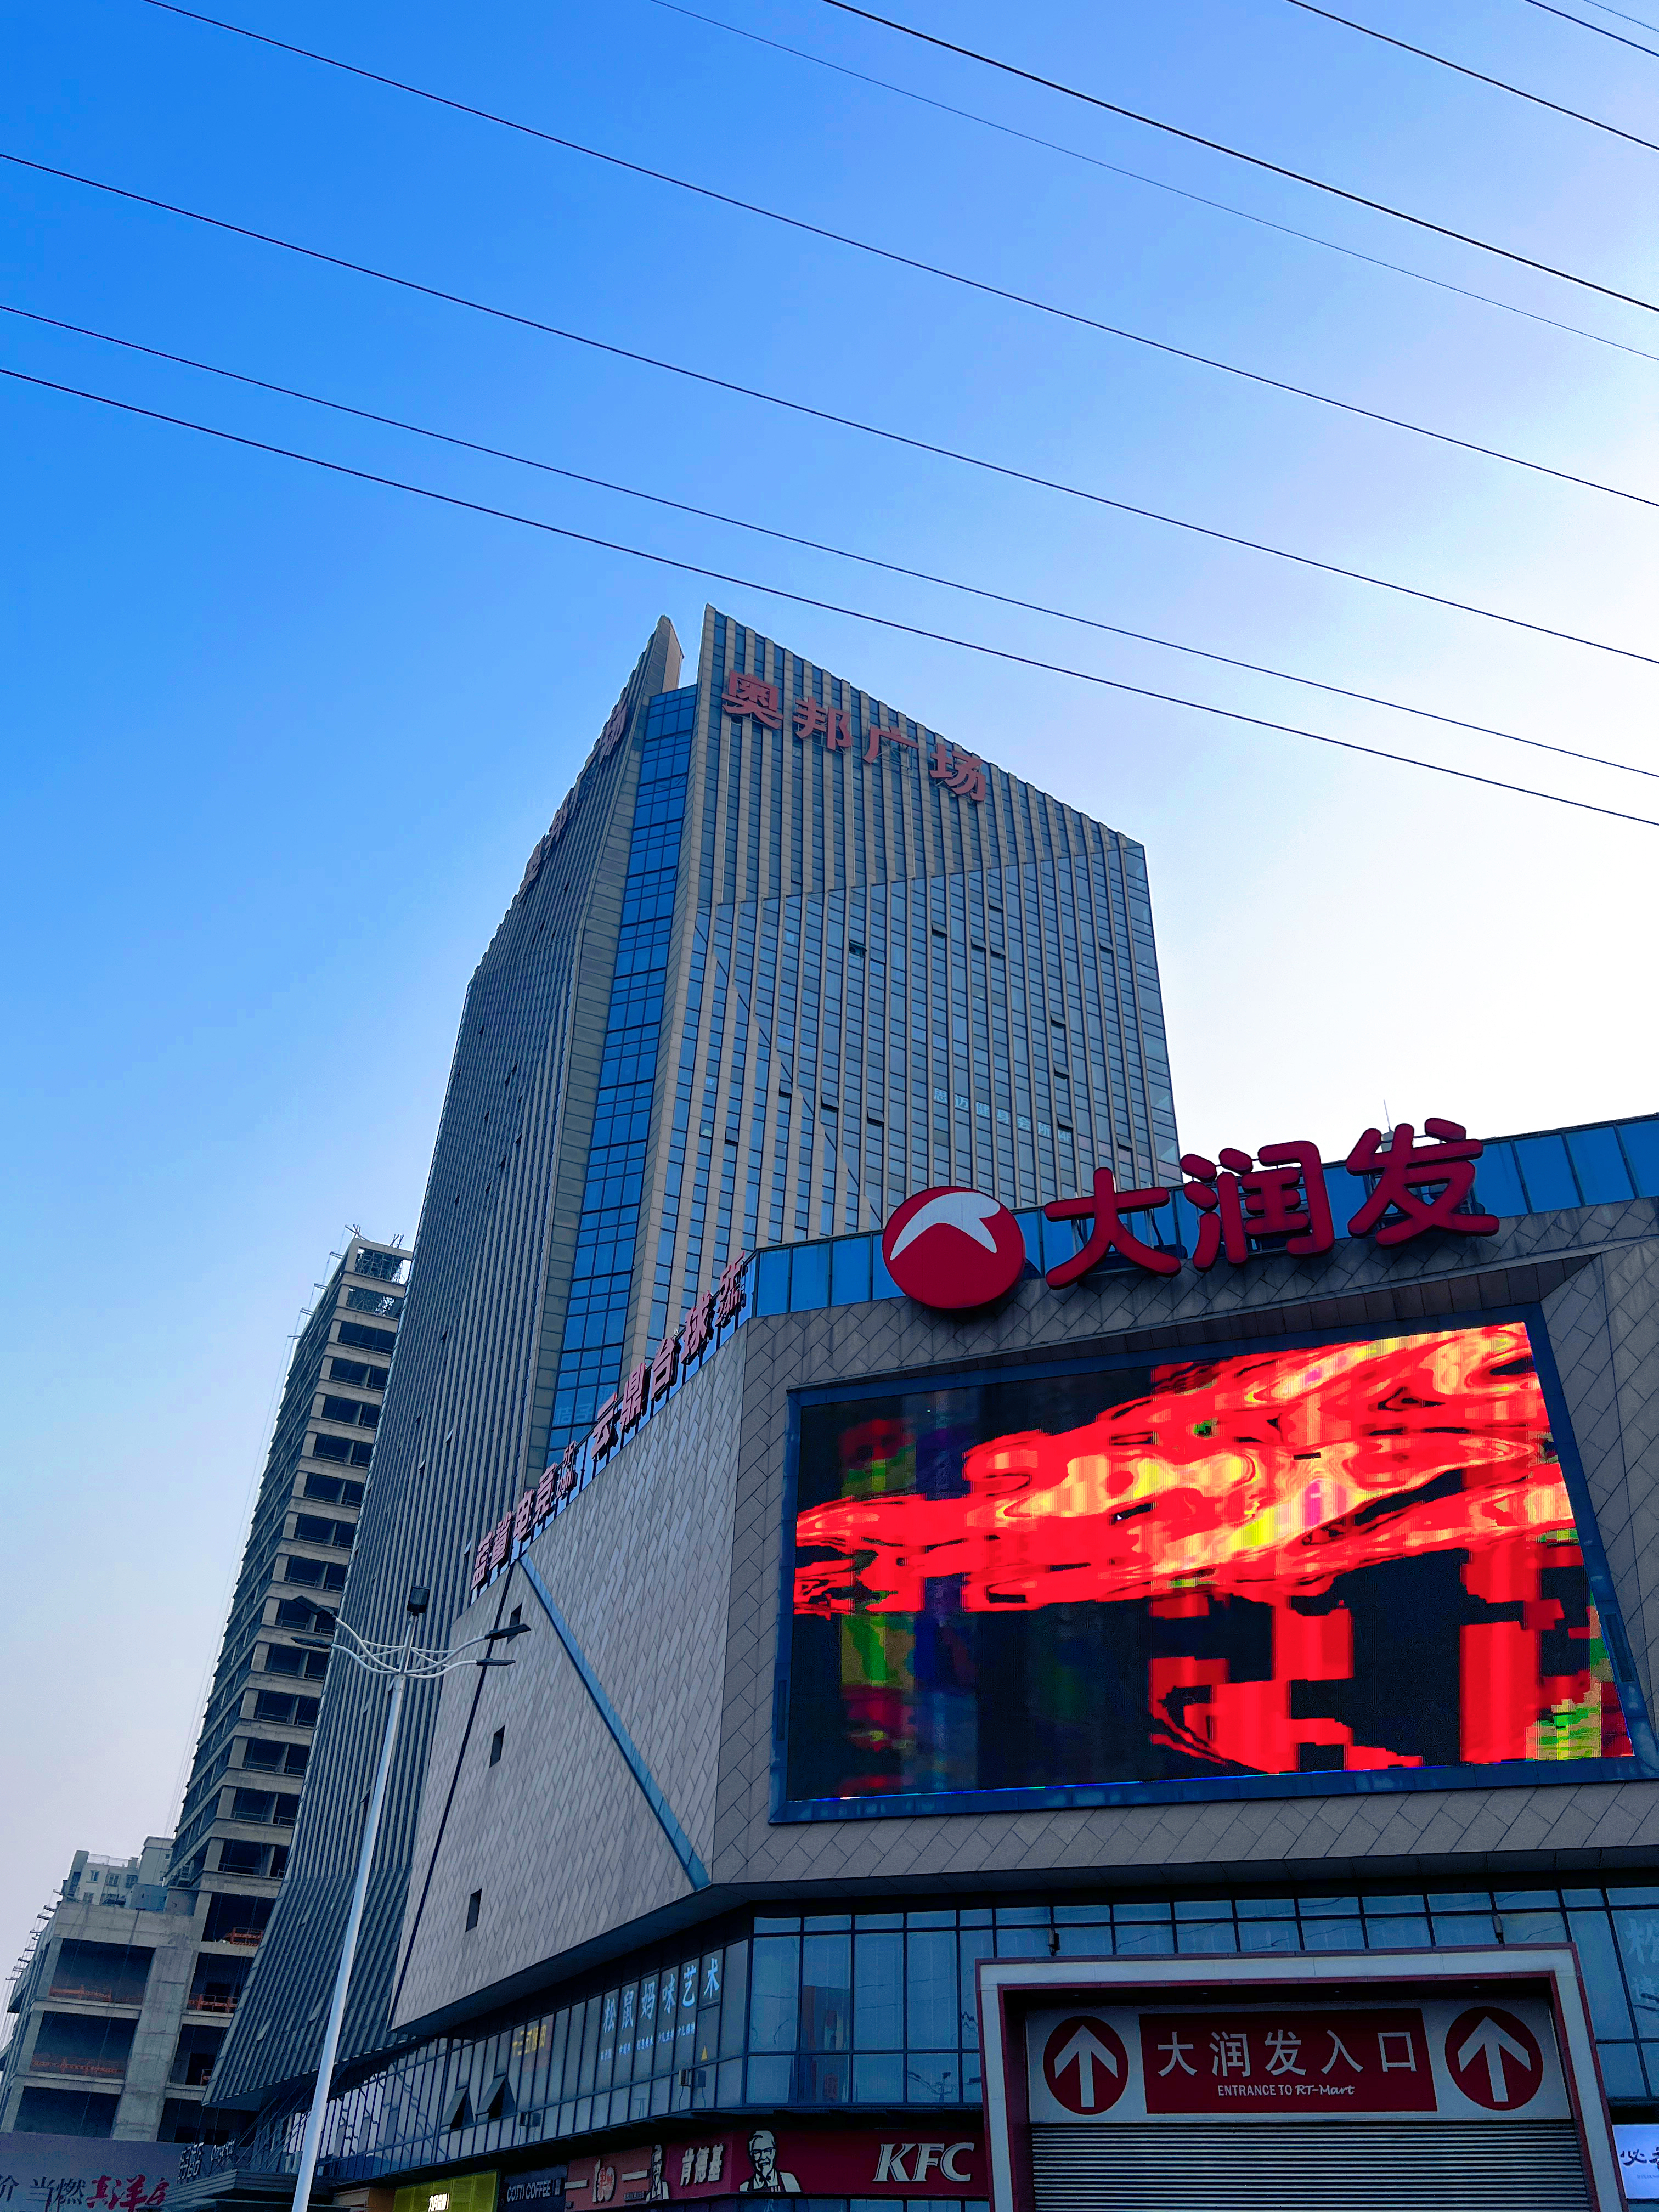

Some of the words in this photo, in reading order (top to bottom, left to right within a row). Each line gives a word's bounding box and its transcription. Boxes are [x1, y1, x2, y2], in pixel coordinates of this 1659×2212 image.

[721, 669, 986, 802] 奥邦广场
[934, 1088, 1052, 1137] 思迈健身会所
[1044, 1117, 1500, 1290] 大润发
[591, 1289, 712, 1459] 云鼎台球
[1157, 2029, 1417, 2077] 大润发入口
[1217, 2084, 1277, 2096] ENTRANCE
[1278, 2084, 1293, 2096] TO
[1295, 2084, 1356, 2096] RT-Mart
[680, 2142, 724, 2186] 肯德基
[871, 2142, 975, 2182] KFC
[506, 2183, 524, 2203] COTTI
[525, 2180, 552, 2200] COFFEE
